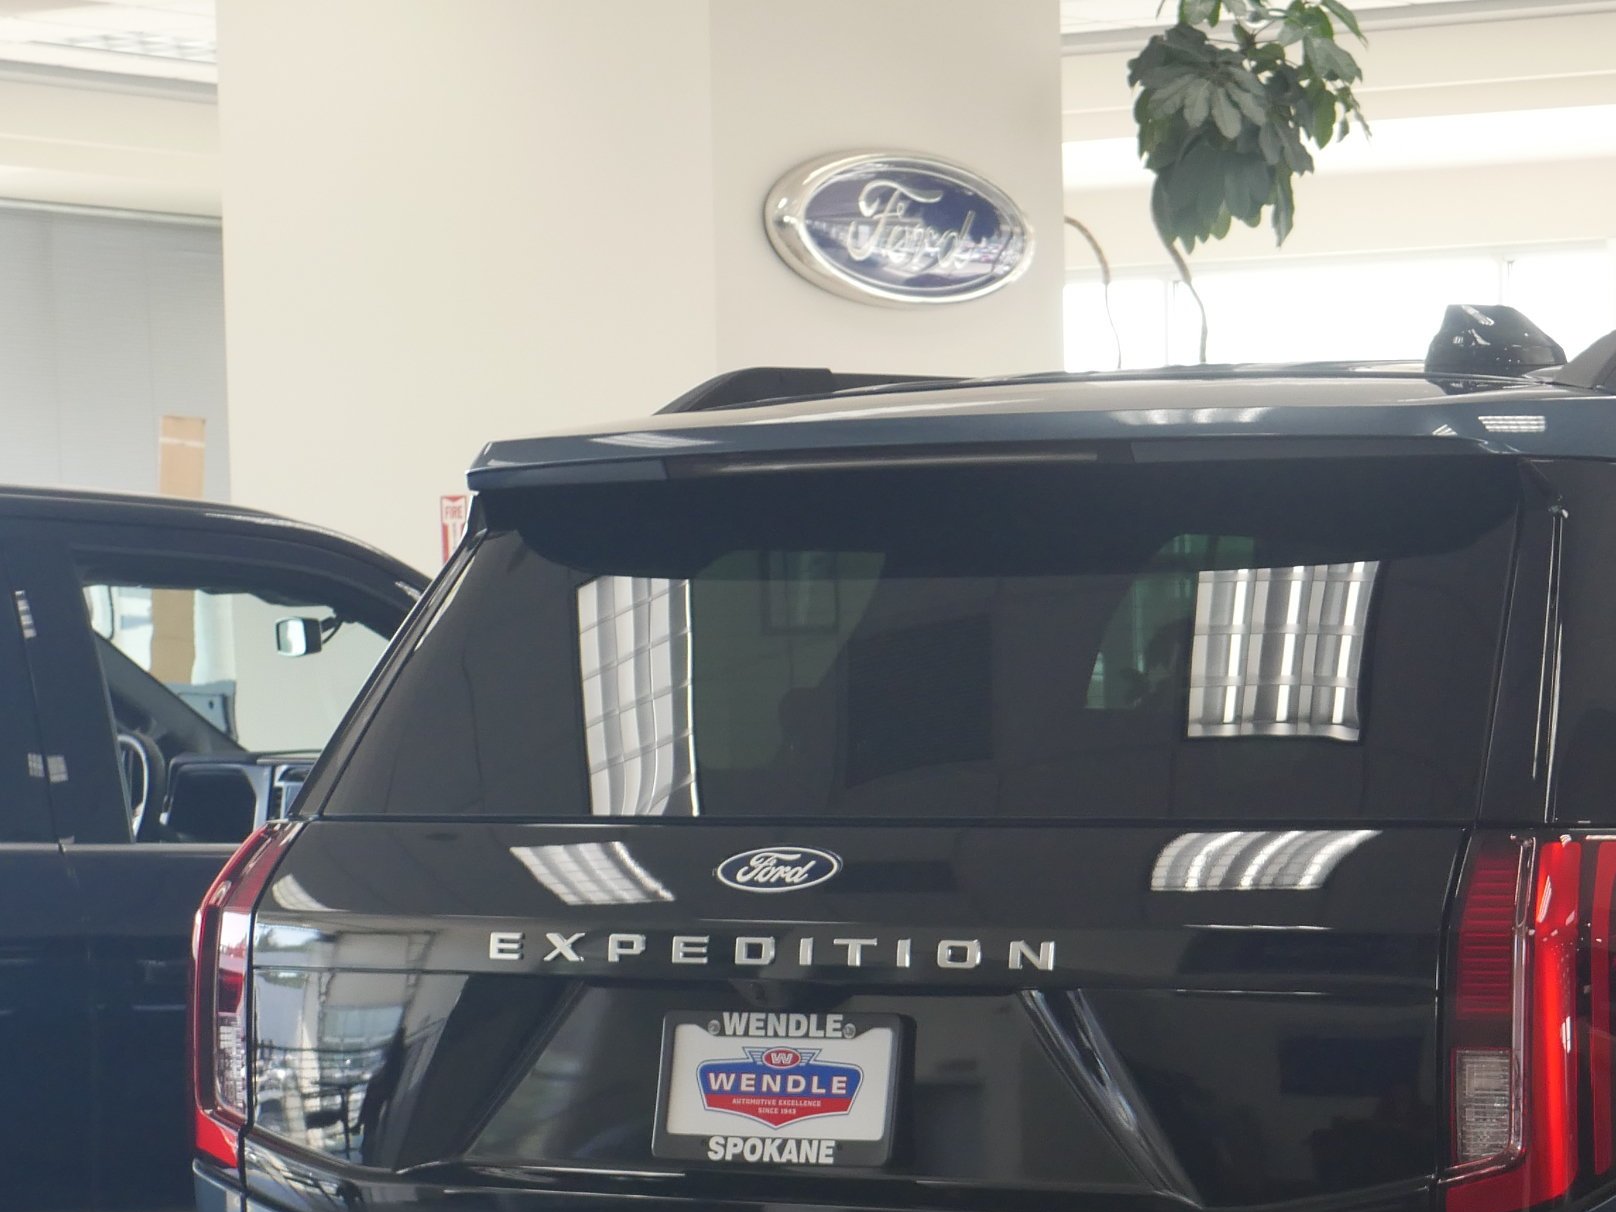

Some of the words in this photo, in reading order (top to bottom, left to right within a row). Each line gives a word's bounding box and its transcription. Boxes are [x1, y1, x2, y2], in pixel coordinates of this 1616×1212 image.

[847, 180, 976, 269] Ford
[445, 505, 463, 519] FIRE
[736, 852, 816, 883] Ford
[489, 931, 1056, 971] EXPEDITION
[722, 1011, 844, 1038] WENDLE
[707, 1072, 848, 1095] WENDLE
[732, 1097, 776, 1106] AUTOMOTIVE
[707, 1135, 836, 1164] SPOKANE
